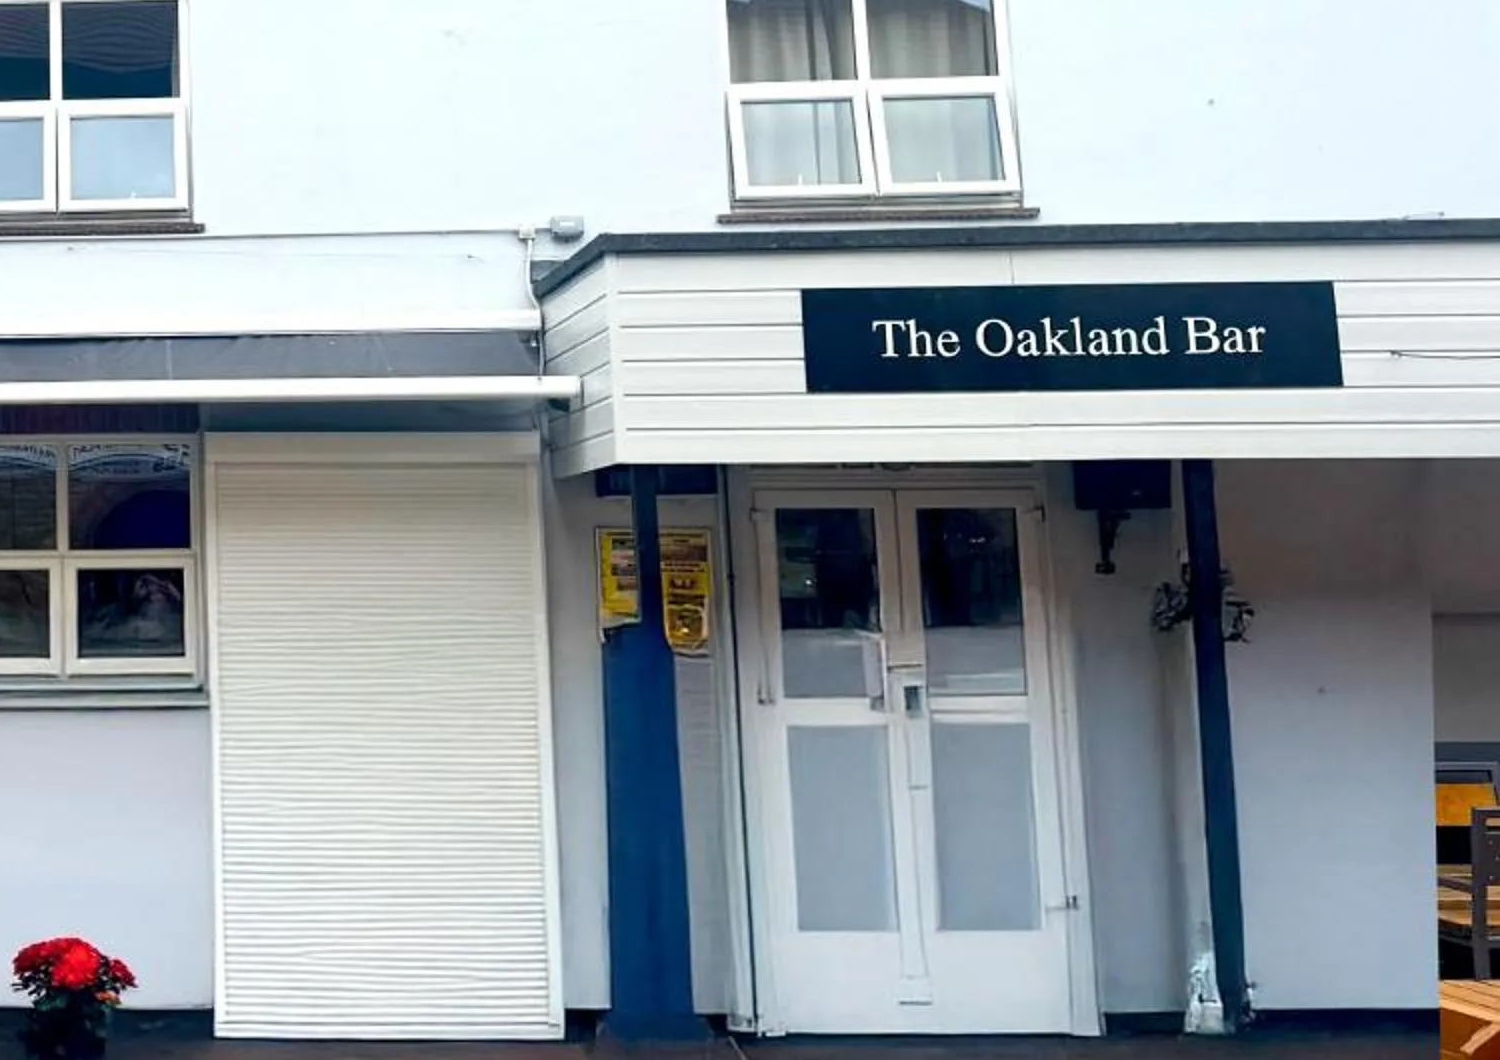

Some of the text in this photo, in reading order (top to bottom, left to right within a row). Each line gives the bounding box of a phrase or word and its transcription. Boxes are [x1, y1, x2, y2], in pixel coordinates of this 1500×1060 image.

[872, 316, 1266, 357] The Oakland Bar
